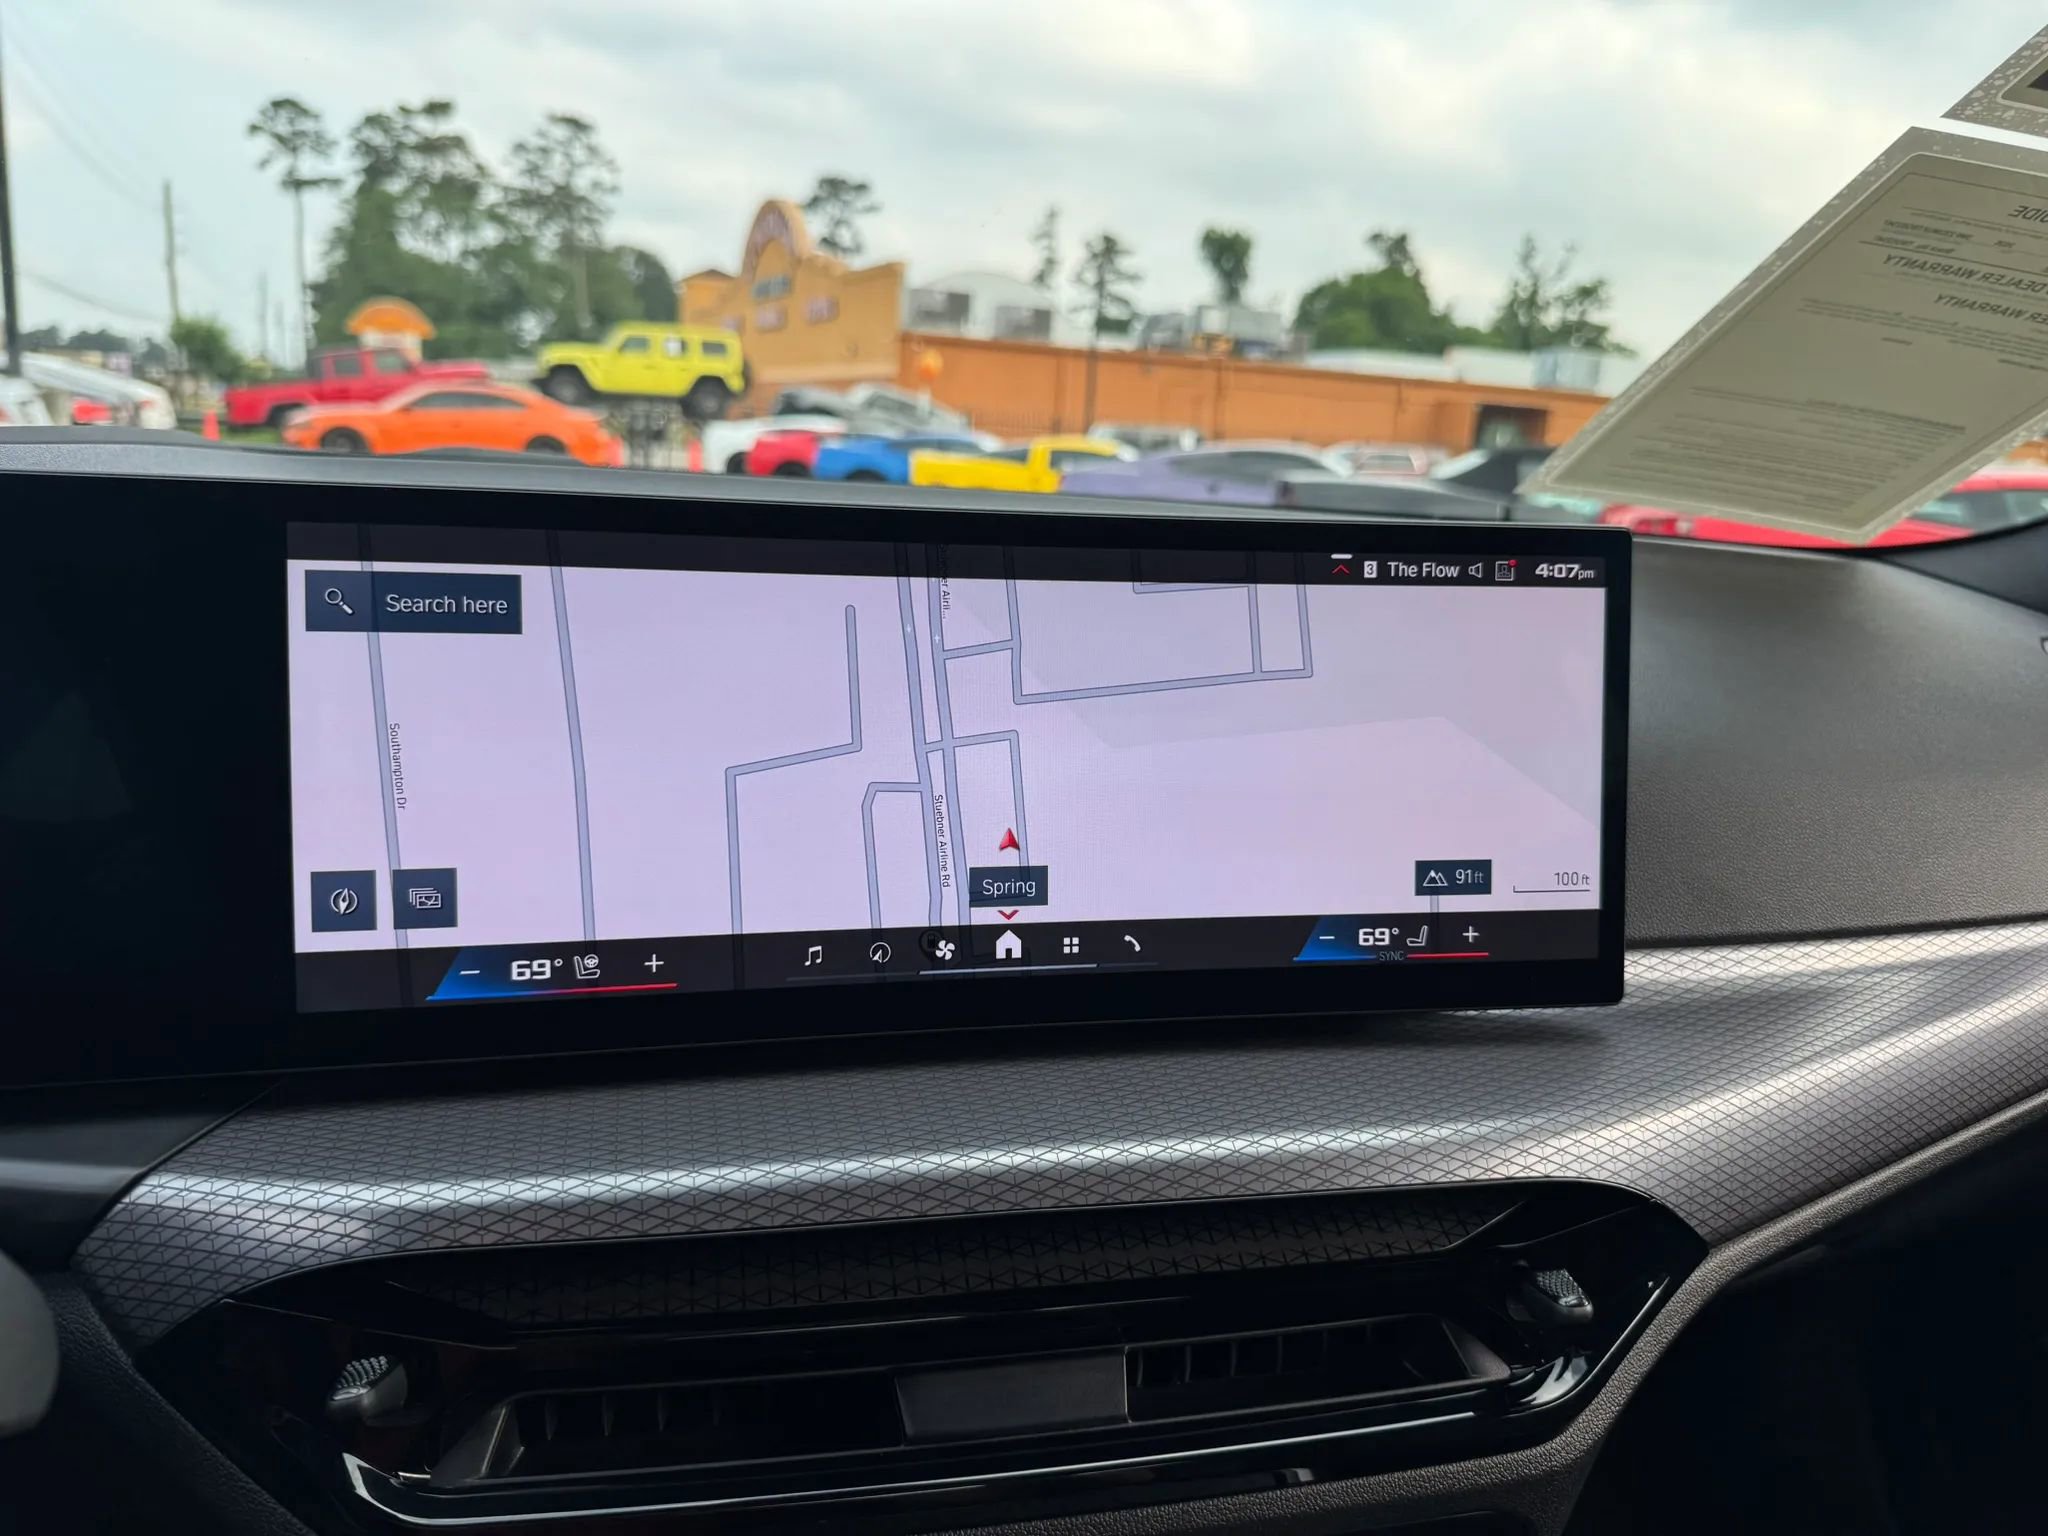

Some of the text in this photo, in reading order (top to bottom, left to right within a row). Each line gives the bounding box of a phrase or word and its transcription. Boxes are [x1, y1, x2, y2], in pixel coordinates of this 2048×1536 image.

[1387, 561, 1418, 578] The
[1422, 561, 1460, 578] Flow
[385, 593, 508, 614] Search here
[389, 722, 407, 810] Southampton Dr
[934, 794, 951, 888] Stuebner Airline Rd
[982, 878, 1036, 898] Spring
[1553, 872, 1590, 886] 100 ft
[1379, 950, 1405, 961] SYNC
